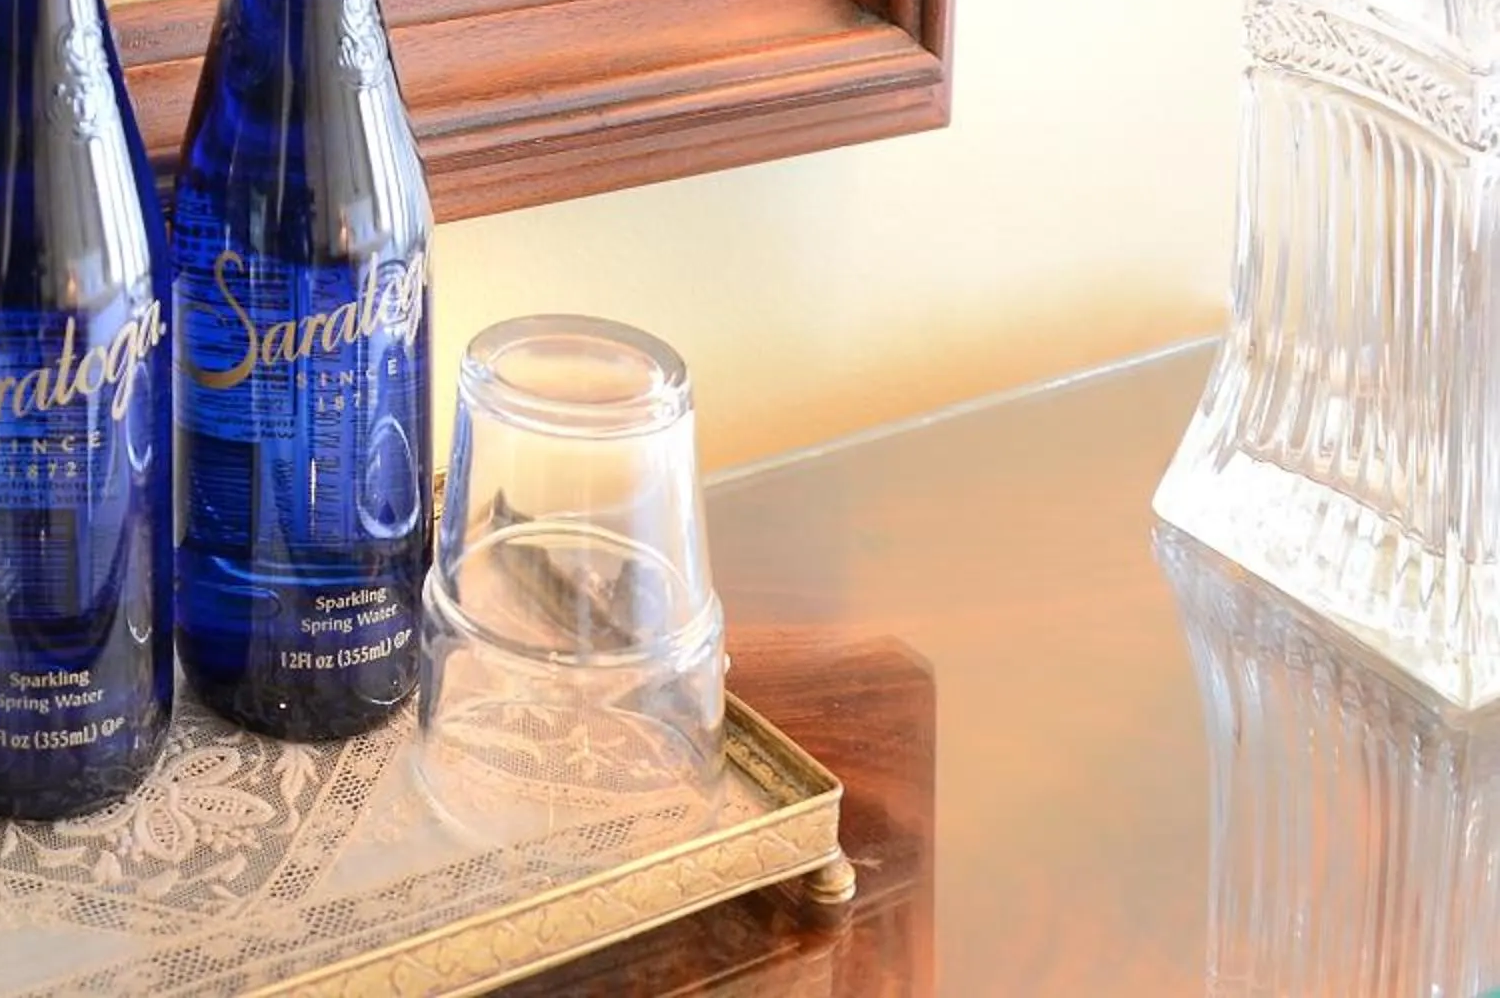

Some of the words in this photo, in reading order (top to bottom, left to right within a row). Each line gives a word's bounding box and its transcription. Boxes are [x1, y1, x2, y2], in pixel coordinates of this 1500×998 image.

[315, 587, 387, 613] Sparkling
[301, 617, 353, 636] Spring
[357, 603, 398, 627] Water
[315, 655, 335, 669] oz
[337, 637, 392, 667] (355mL)
[9, 669, 90, 692] Sparkling
[55, 689, 104, 707] Water
[10, 732, 30, 749] oz
[34, 723, 97, 750] (355mL)
